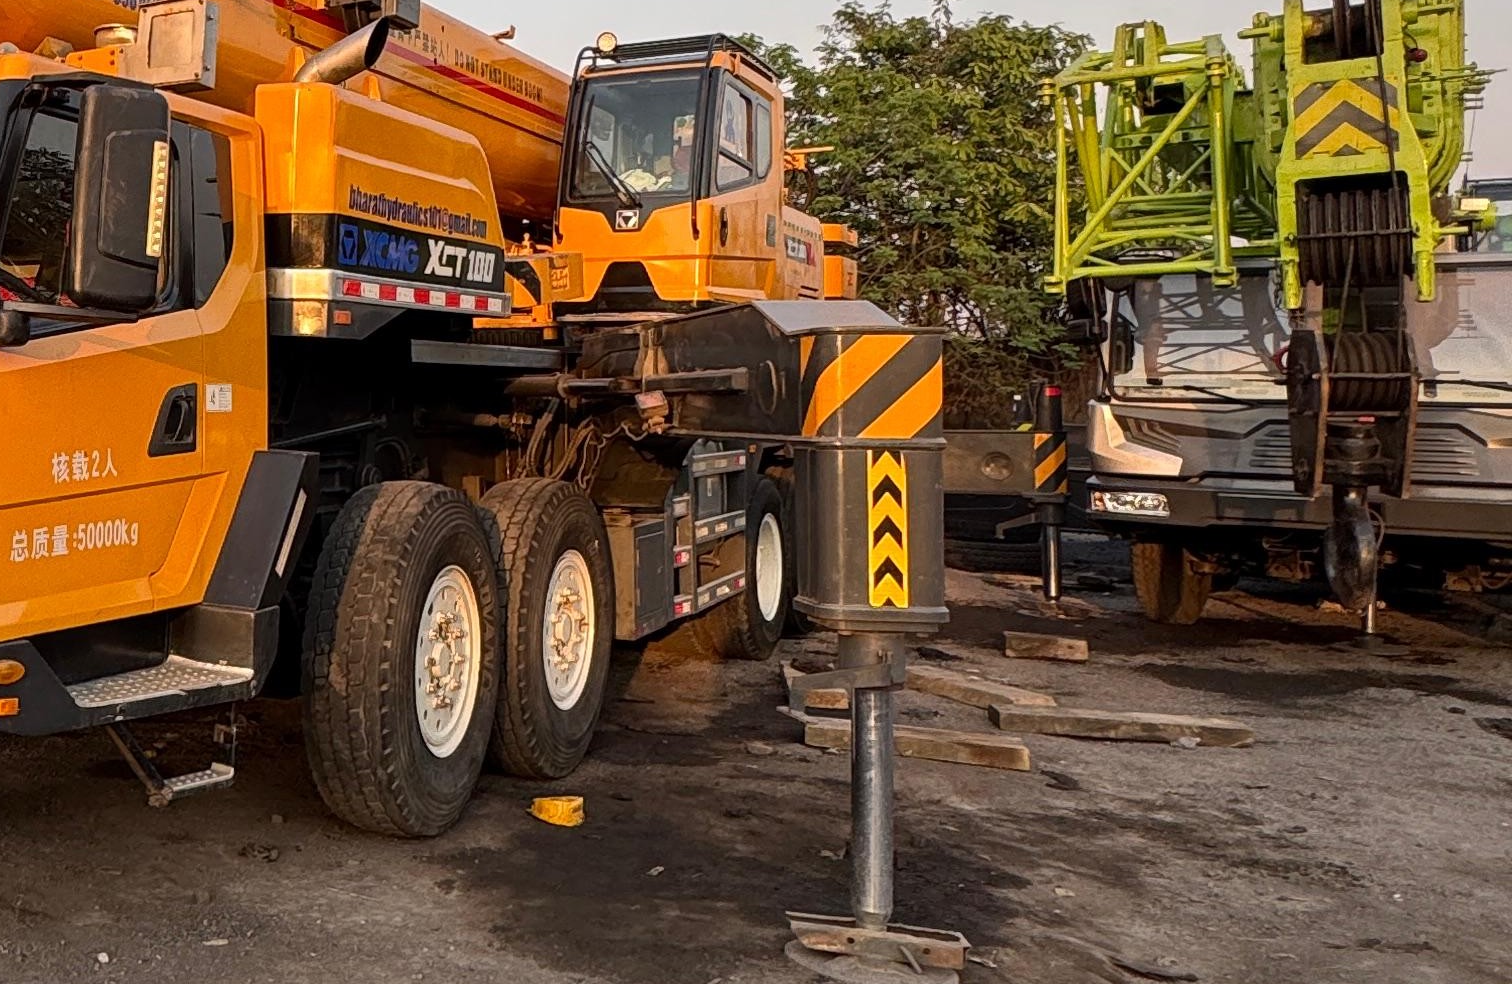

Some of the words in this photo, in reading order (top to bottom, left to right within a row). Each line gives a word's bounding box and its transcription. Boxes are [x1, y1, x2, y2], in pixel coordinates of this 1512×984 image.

[360, 229, 419, 274] XCMG
[52, 448, 118, 484] 核载2人
